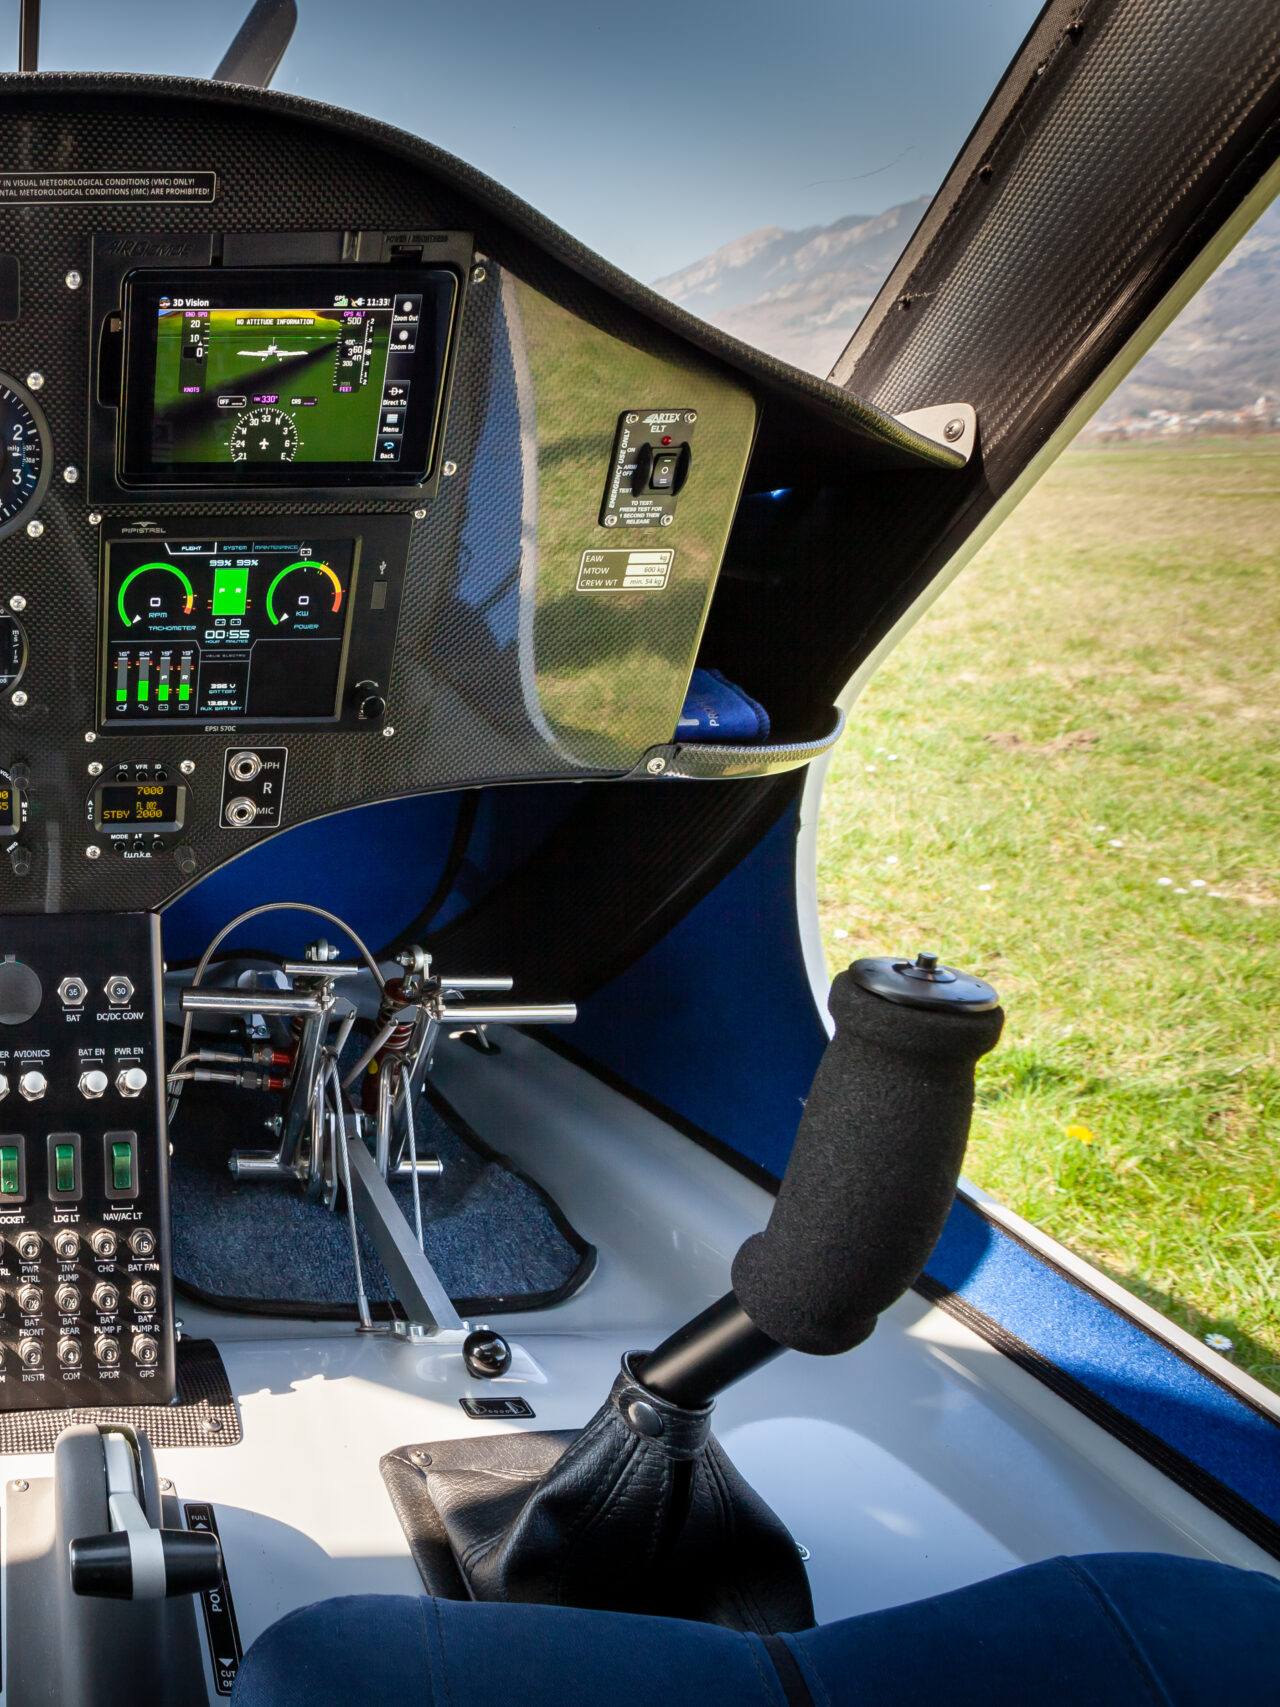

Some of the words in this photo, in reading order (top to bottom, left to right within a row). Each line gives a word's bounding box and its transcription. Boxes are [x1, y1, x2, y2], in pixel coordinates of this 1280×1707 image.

[3, 180, 12, 188] IN
[13, 178, 38, 187] VISUAL
[39, 178, 104, 187] METEOROLOGICAL
[104, 178, 150, 186] CONDITIONS
[150, 178, 172, 188] (VMC)
[173, 178, 195, 186] ONLY!
[173, 298, 184, 306] 3D
[186, 298, 210, 306] Vision
[190, 320, 200, 328] 20
[190, 334, 200, 342] 10
[196, 348, 203, 358] 0
[250, 418, 259, 426] 30
[262, 414, 271, 422] 33
[650, 424, 666, 432] ELT
[622, 428, 630, 448] ONLY
[236, 440, 246, 448] 24
[618, 449, 627, 464] USE
[608, 465, 623, 508] EMERGENCY
[583, 567, 610, 575] MTOW
[644, 566, 656, 574] 600
[656, 566, 664, 574] kg
[204, 630, 250, 640] 00:55
[136, 786, 164, 795] 7000
[263, 782, 272, 794] R
[104, 810, 130, 819] STBY
[136, 810, 163, 818] 2000
[68, 988, 78, 996] 35
[116, 987, 126, 995] 30
[66, 1014, 81, 1022] BAT
[96, 1014, 121, 1022] DC/DC
[122, 1012, 144, 1020] CONV
[14, 1050, 50, 1058] AVIONICS
[78, 1048, 94, 1056] BAT
[95, 1048, 106, 1056] EN
[114, 1048, 132, 1056] PWR
[54, 1215, 69, 1224] LDG
[70, 1214, 80, 1222] LT
[103, 1212, 132, 1221] NAV/AC
[133, 1212, 143, 1220] LT
[22, 1265, 40, 1274] PWR
[61, 1264, 75, 1272] INV
[98, 1264, 114, 1273] CHG
[128, 1264, 142, 1272] BAT
[144, 1263, 160, 1272] FAN
[21, 1275, 40, 1284] CTRL
[58, 1274, 79, 1282] PUMP
[24, 1319, 40, 1327] BAT
[62, 1318, 77, 1326] BAT
[100, 1316, 116, 1324] BAT
[138, 1315, 152, 1323] BAT
[20, 1328, 45, 1336] FRONT
[60, 1328, 80, 1336] REAR
[22, 1374, 46, 1382] INSTR
[62, 1372, 80, 1380] COM
[99, 1371, 120, 1379] XPDR
[140, 1370, 155, 1378] GPS
